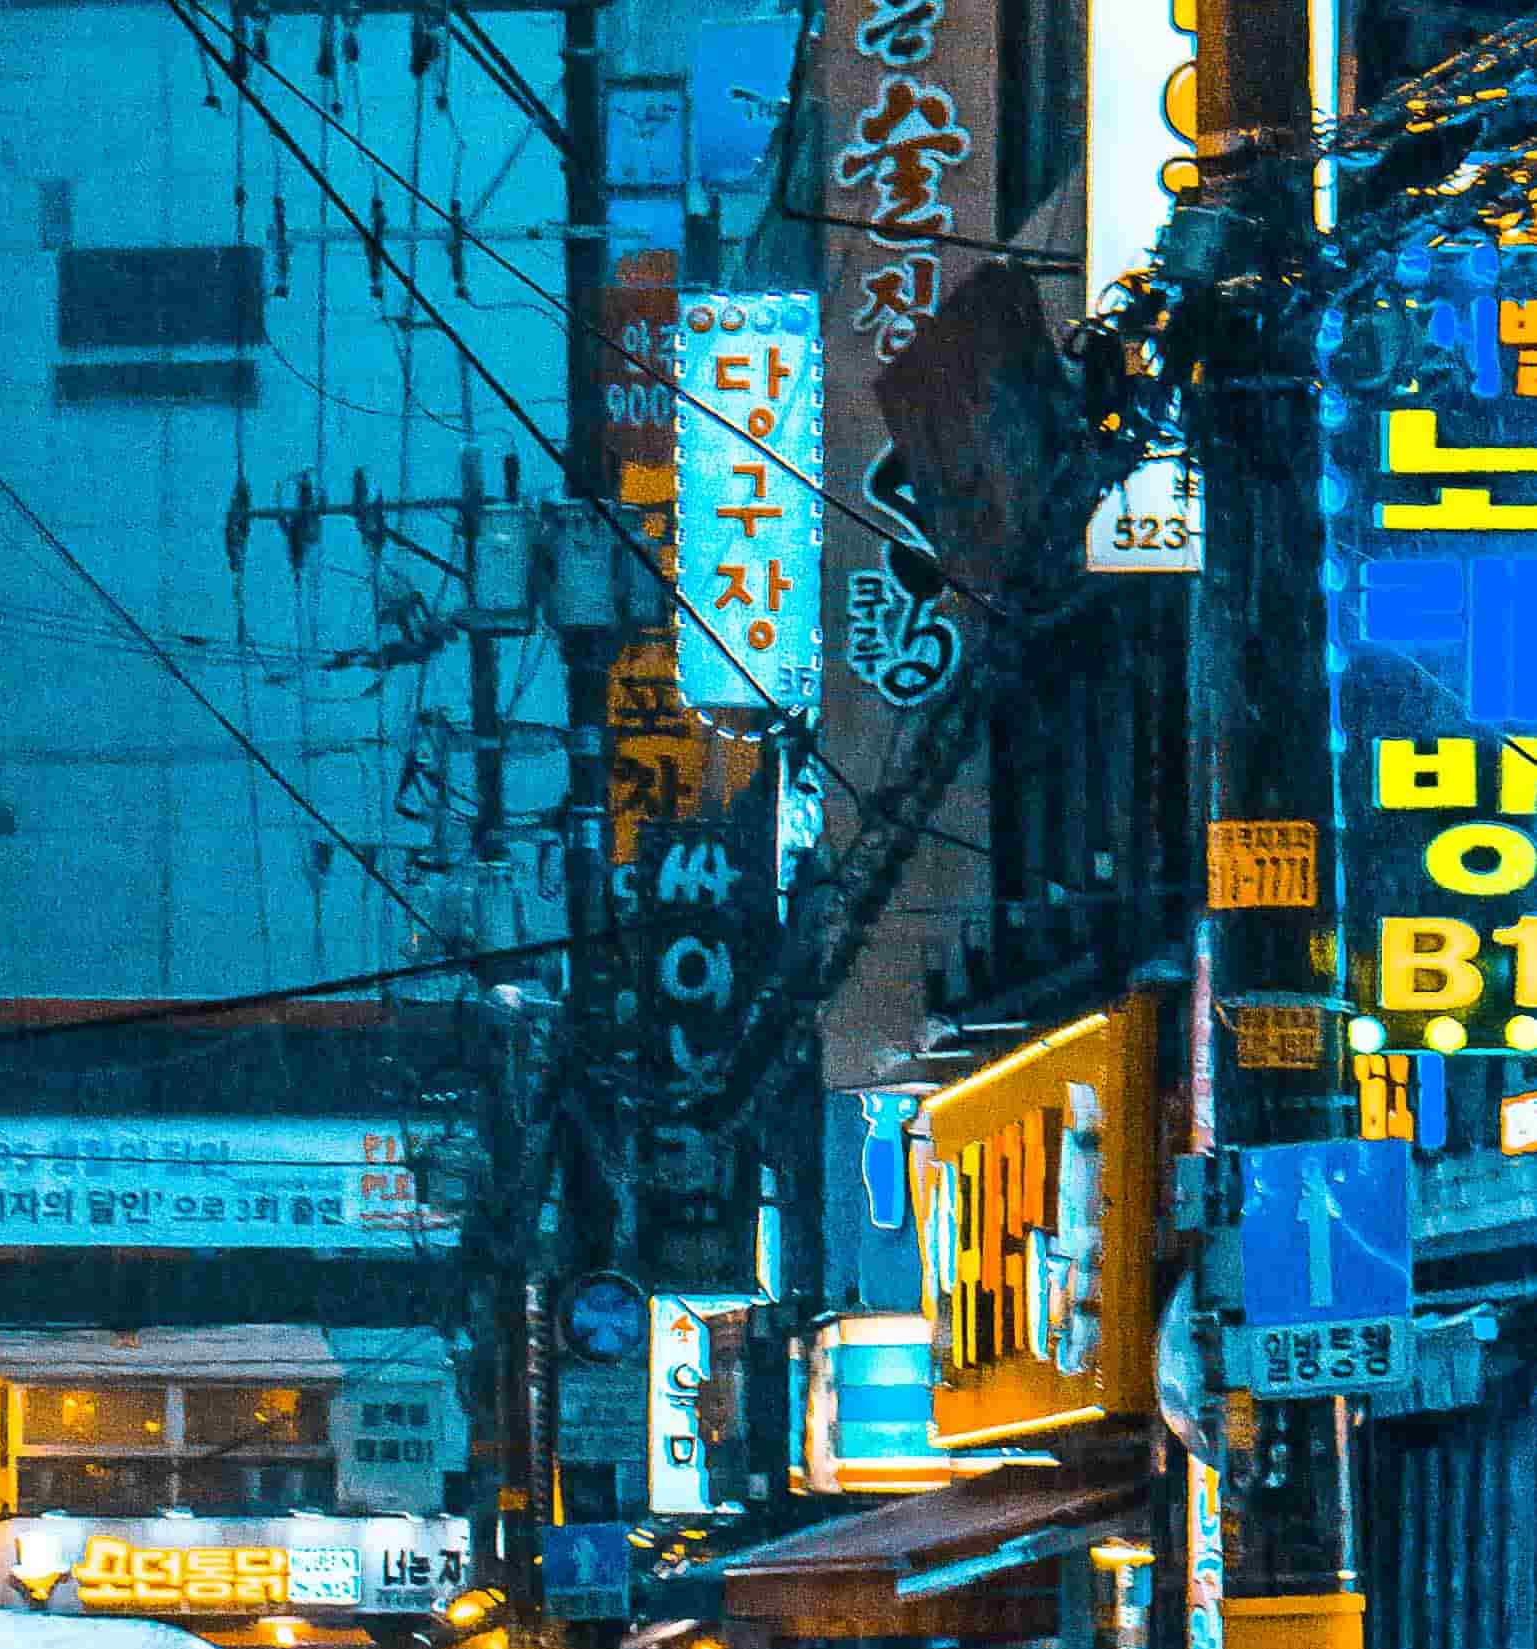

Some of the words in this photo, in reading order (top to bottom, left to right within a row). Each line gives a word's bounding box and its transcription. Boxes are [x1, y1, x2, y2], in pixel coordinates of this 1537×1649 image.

[714, 346, 794, 652] 당구장
[1113, 516, 1189, 551] 523
[1381, 915, 1537, 1012] B1
